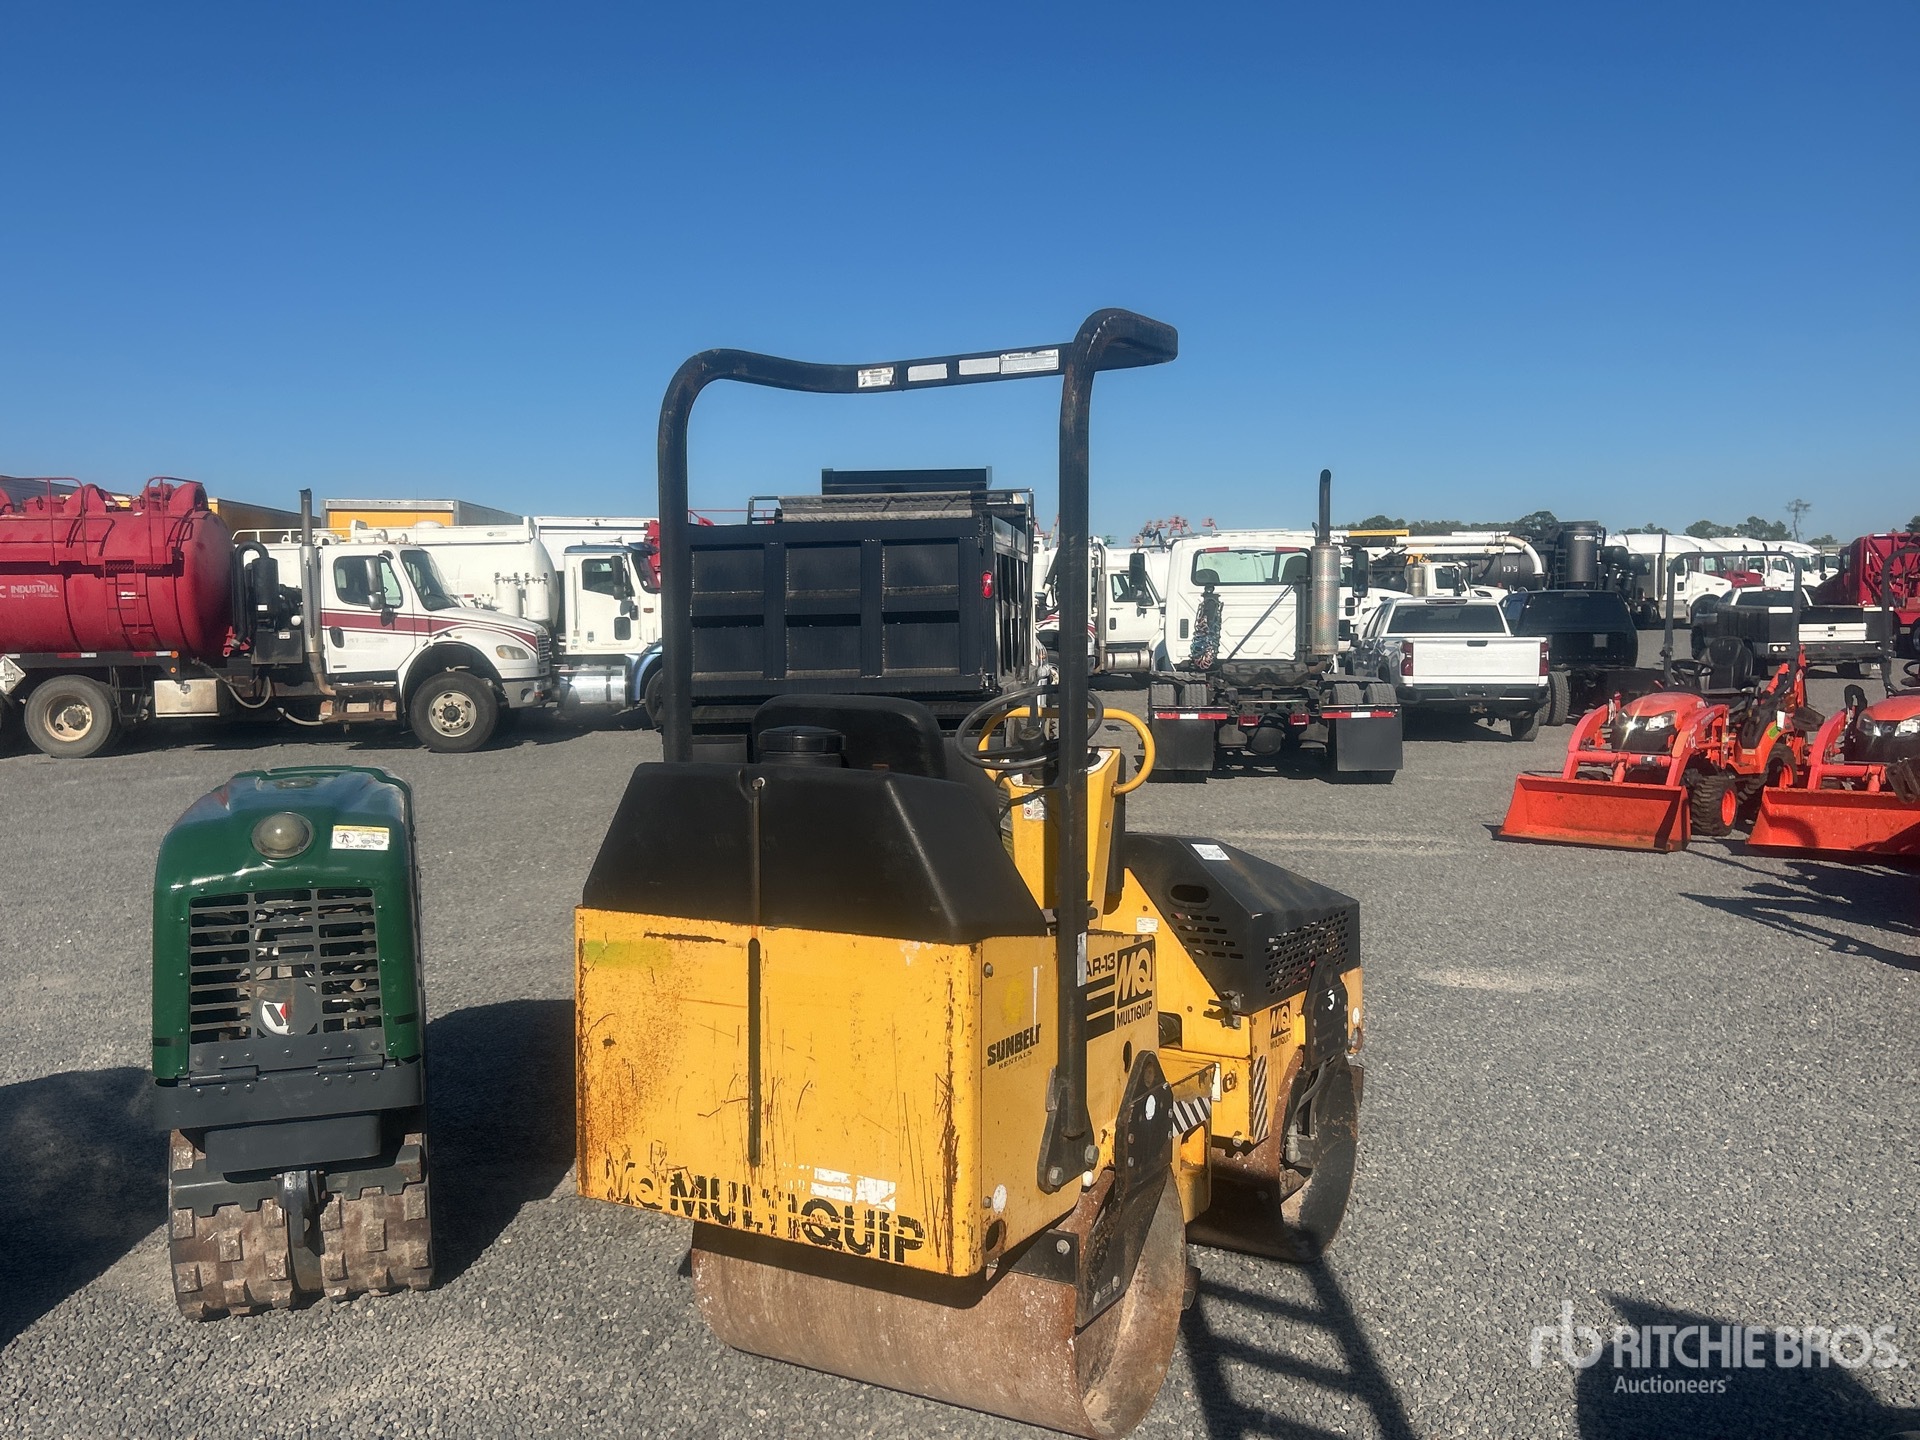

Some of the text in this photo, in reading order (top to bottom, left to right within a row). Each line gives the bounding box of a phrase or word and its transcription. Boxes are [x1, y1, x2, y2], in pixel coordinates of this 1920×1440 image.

[11, 584, 59, 594] INDUSTRIAL
[1117, 946, 1153, 1004] MQ
[1116, 1000, 1153, 1029] MULTIQUIP
[987, 1022, 1042, 1067] SUNBELT
[998, 1049, 1033, 1070] RENTALS
